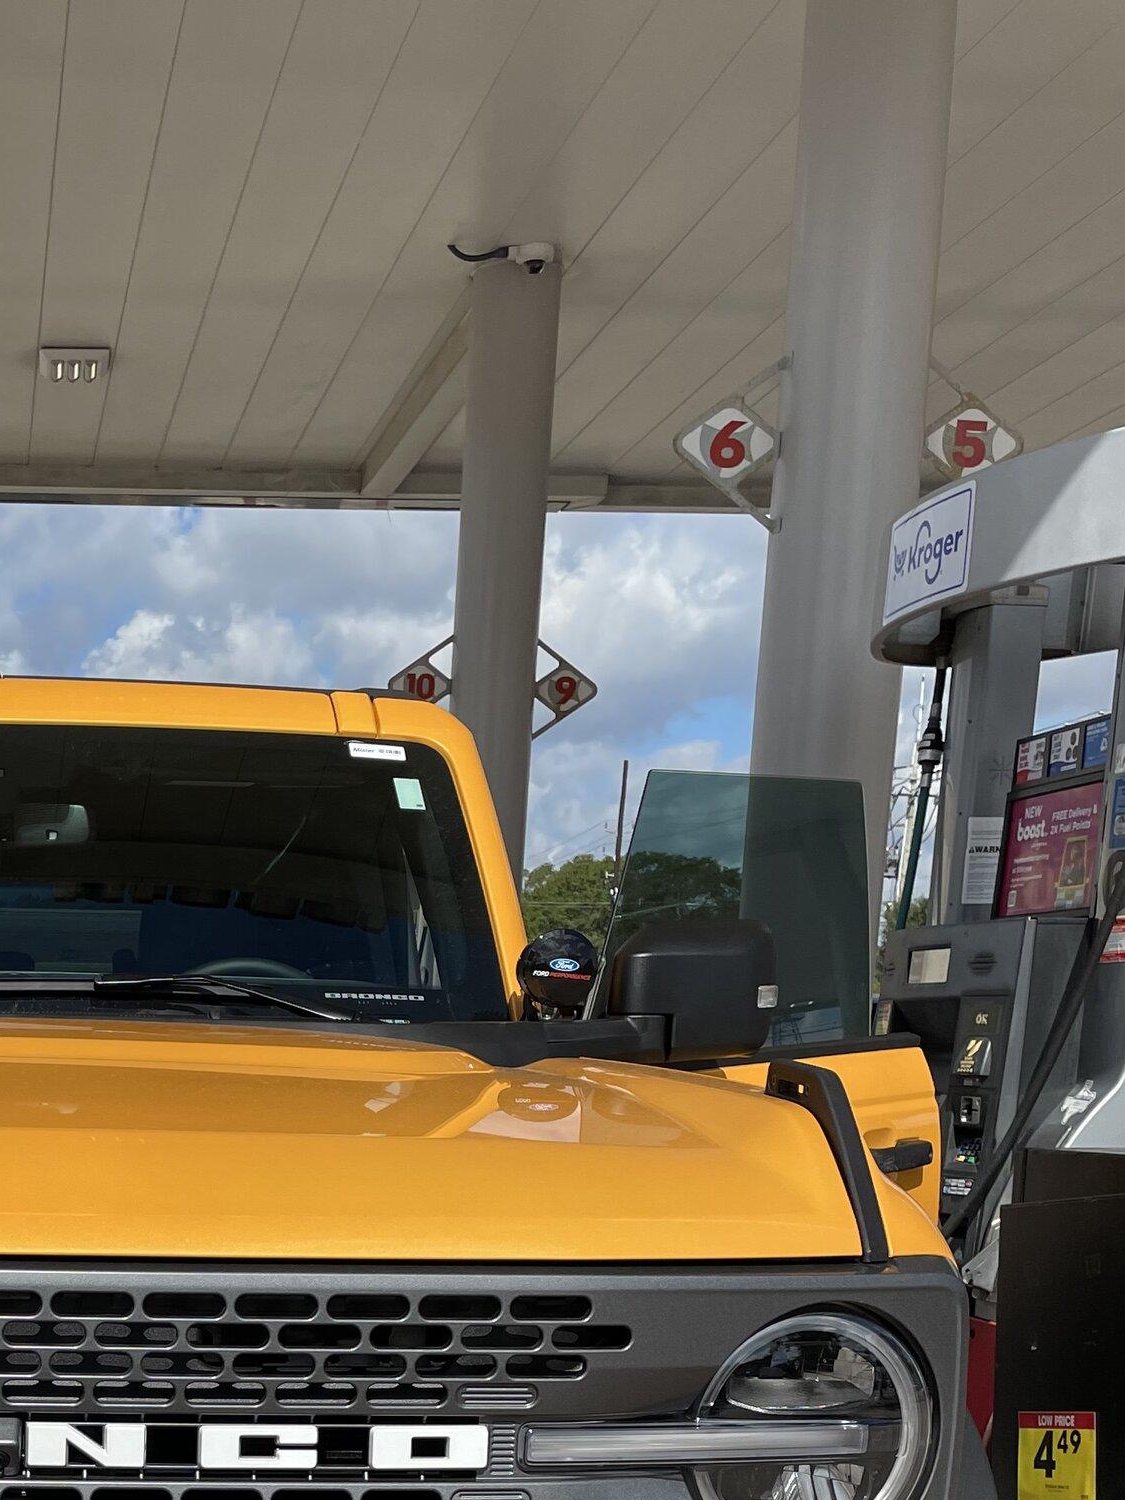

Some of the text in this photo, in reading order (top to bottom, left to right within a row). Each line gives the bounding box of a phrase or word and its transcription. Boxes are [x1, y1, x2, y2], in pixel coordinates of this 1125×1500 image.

[709, 420, 748, 468] 6
[952, 419, 988, 468] 5
[907, 520, 964, 585] Kroger
[406, 673, 436, 700] 10
[555, 676, 577, 705] 9
[1025, 805, 1043, 819] NEW
[1052, 809, 1068, 821] FREE
[1068, 807, 1092, 819] Delivery
[549, 971, 592, 981] PERFORMANCE
[324, 992, 425, 1002] BRONCO
[1037, 1414, 1075, 1427] LOW PRICE
